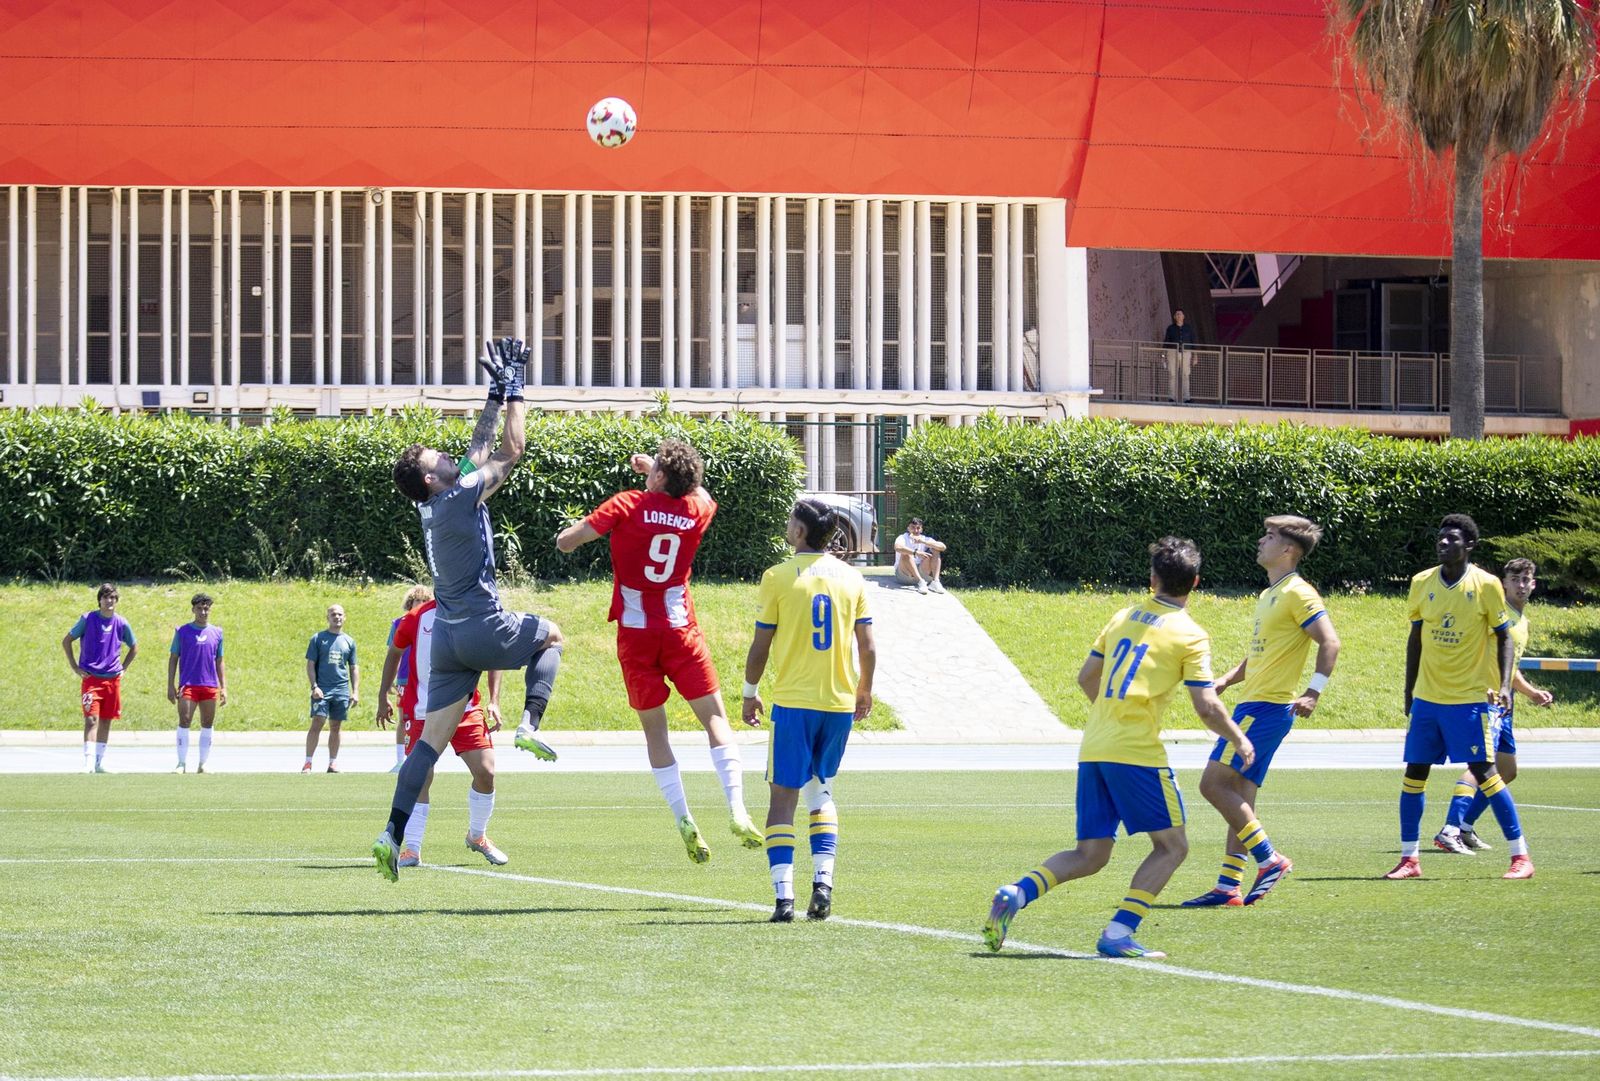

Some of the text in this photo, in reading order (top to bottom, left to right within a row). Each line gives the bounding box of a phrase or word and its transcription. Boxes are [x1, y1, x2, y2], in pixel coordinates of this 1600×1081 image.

[643, 510, 696, 530] LORENZO
[644, 533, 681, 583] 9
[812, 593, 833, 652] 9
[1104, 638, 1150, 701] 21
[82, 693, 93, 705] 23
